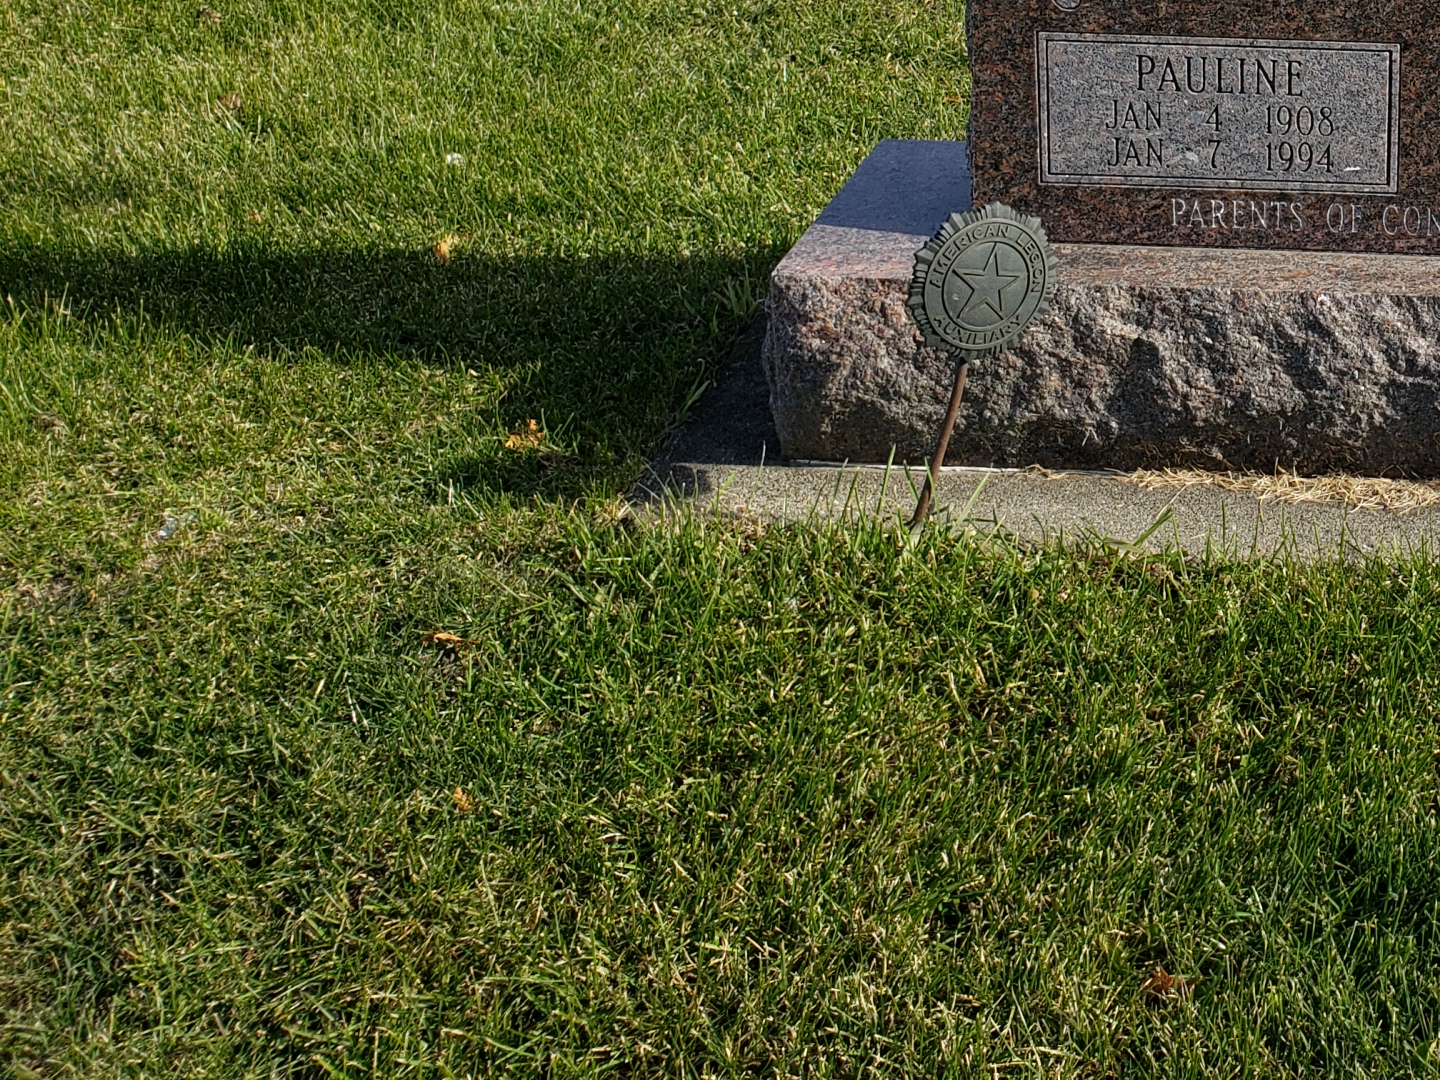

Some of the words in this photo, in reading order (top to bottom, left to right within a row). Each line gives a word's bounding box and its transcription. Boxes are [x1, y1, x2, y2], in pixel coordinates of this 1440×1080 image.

[1135, 53, 1304, 97] PAULINE
[1264, 104, 1335, 137] 1908
[1264, 140, 1335, 173] 1994
[1171, 198, 1303, 233] PARENTS
[1326, 203, 1364, 234] OF
[929, 224, 1011, 289] AMERICAN
[1015, 232, 1044, 294] LEGION
[933, 314, 1022, 345] AUXILIARY
